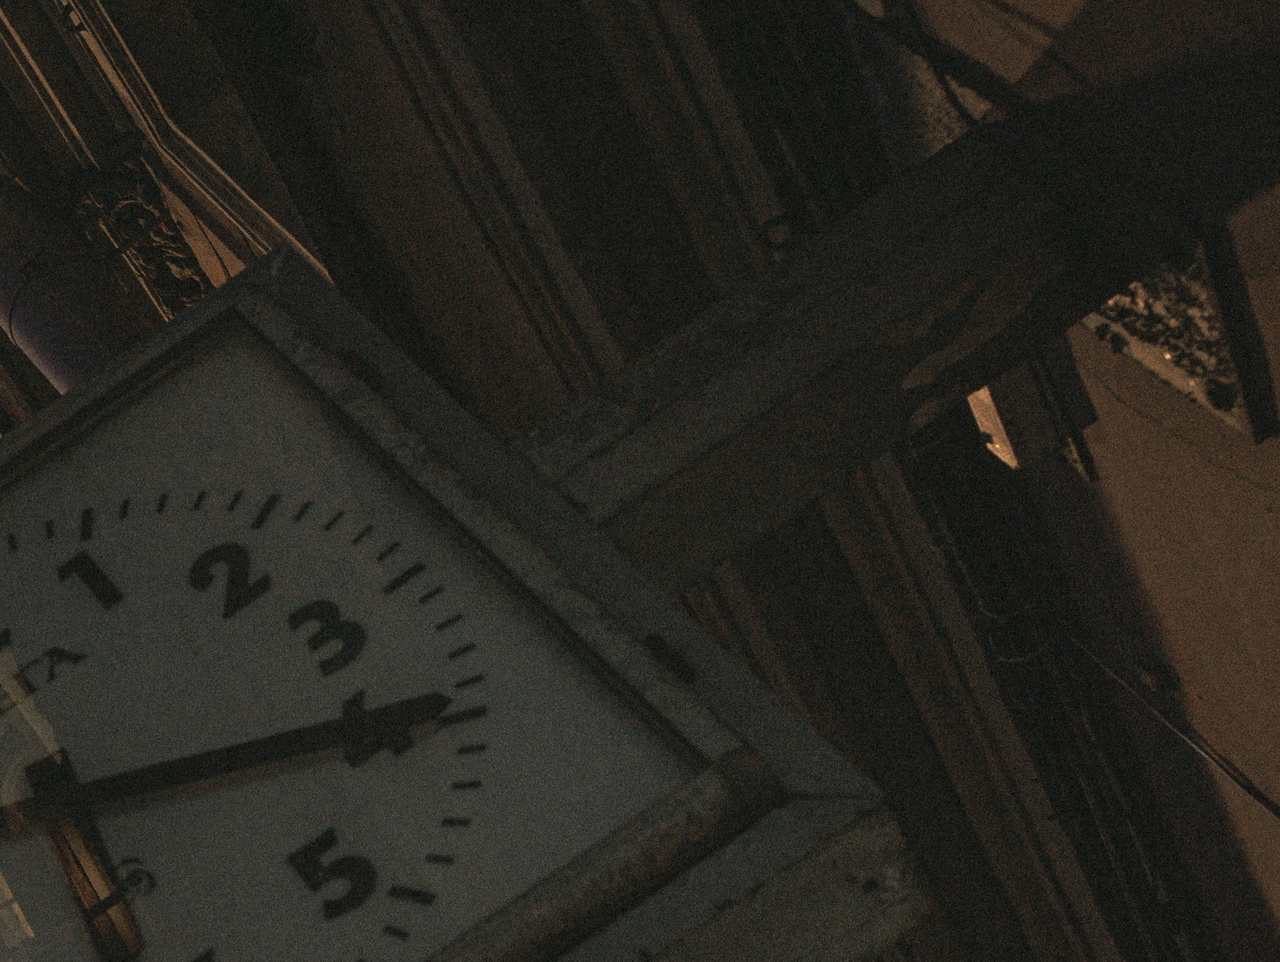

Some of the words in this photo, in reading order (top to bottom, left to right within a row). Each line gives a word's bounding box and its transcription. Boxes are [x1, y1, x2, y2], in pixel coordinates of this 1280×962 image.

[57, 551, 123, 609] 1
[189, 541, 271, 619] 2
[287, 600, 367, 676] 3
[286, 827, 377, 919] 5
